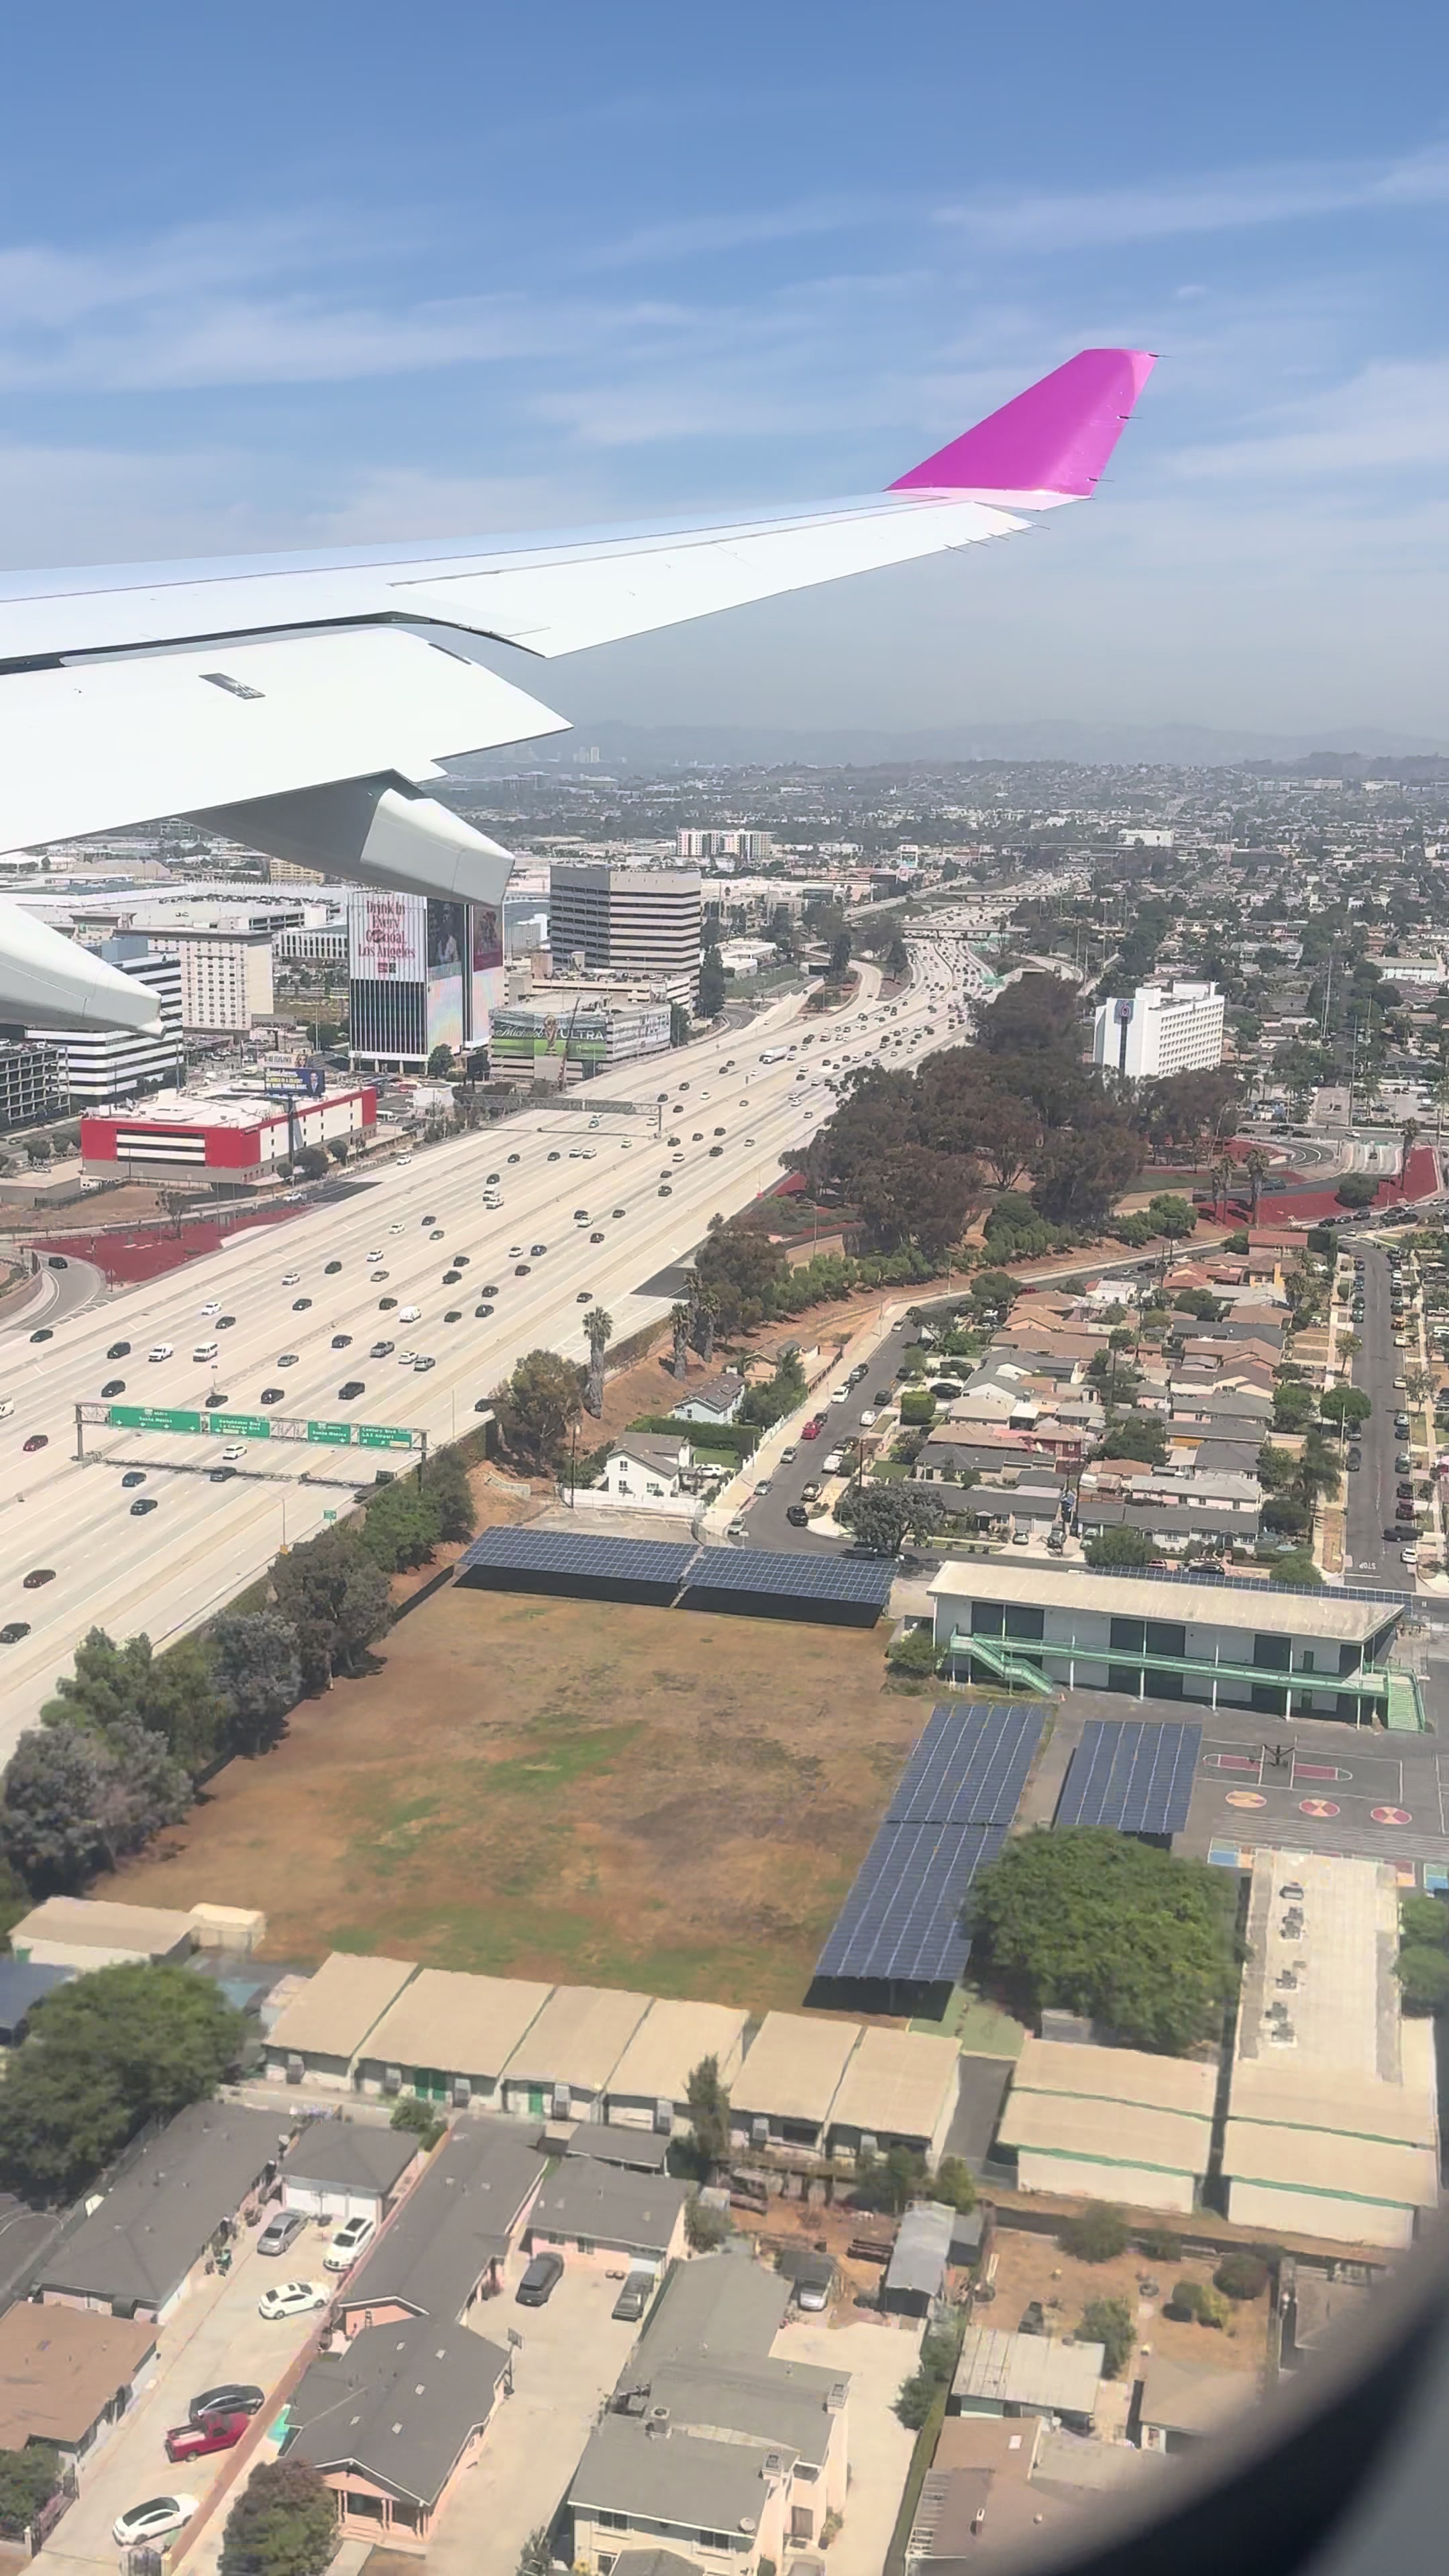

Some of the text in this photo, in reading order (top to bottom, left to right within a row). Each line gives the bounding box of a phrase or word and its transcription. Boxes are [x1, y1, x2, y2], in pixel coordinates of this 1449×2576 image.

[367, 901, 405, 915] Drink In
[373, 915, 400, 929] Every
[358, 943, 415, 961] Los Angeles
[496, 1024, 604, 1040] Michelob ULTRA
[1358, 1562, 1376, 1570] STOP
